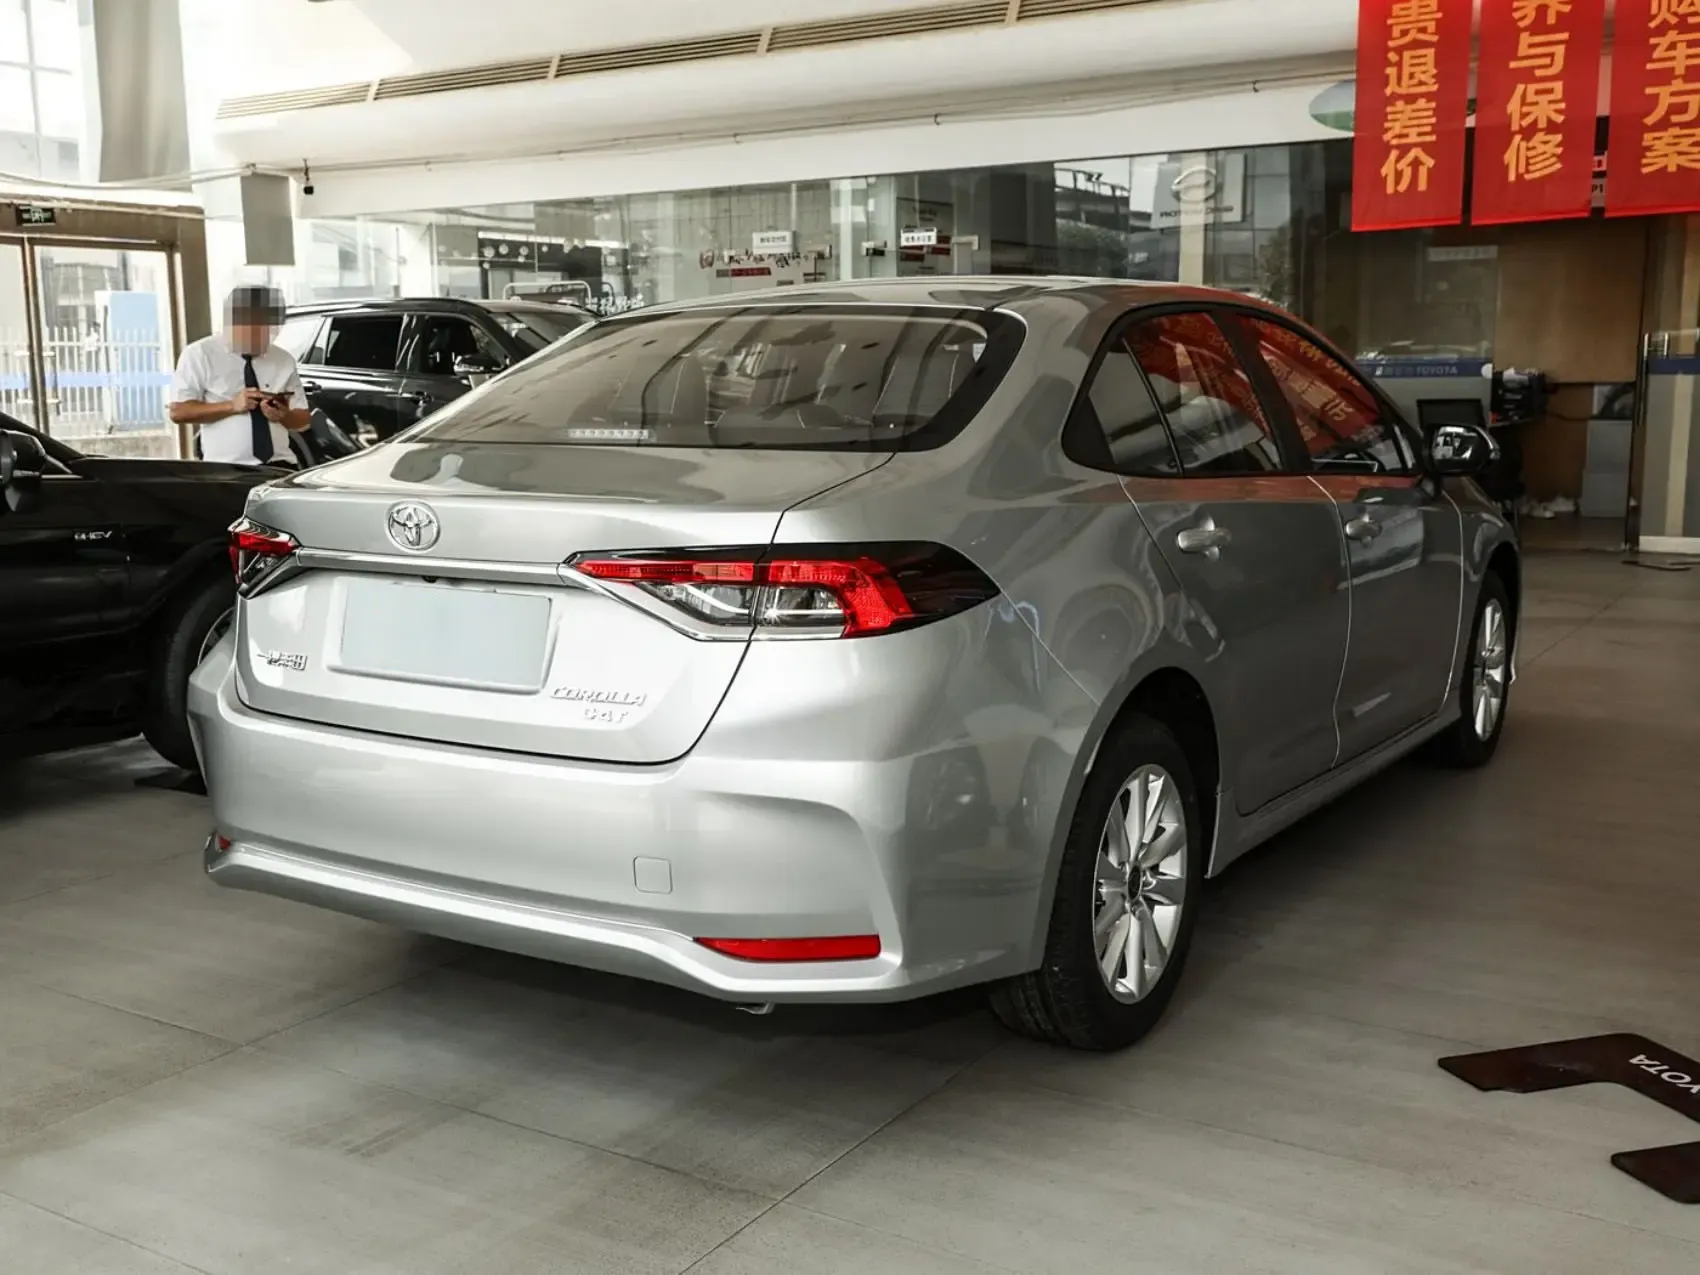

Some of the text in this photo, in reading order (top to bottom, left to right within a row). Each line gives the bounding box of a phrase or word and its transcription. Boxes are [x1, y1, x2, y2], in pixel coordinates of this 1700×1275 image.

[1381, 0, 1443, 194] 贵退差价
[1503, 0, 1573, 182] 养与保修
[1640, 0, 1700, 174] 购车方案
